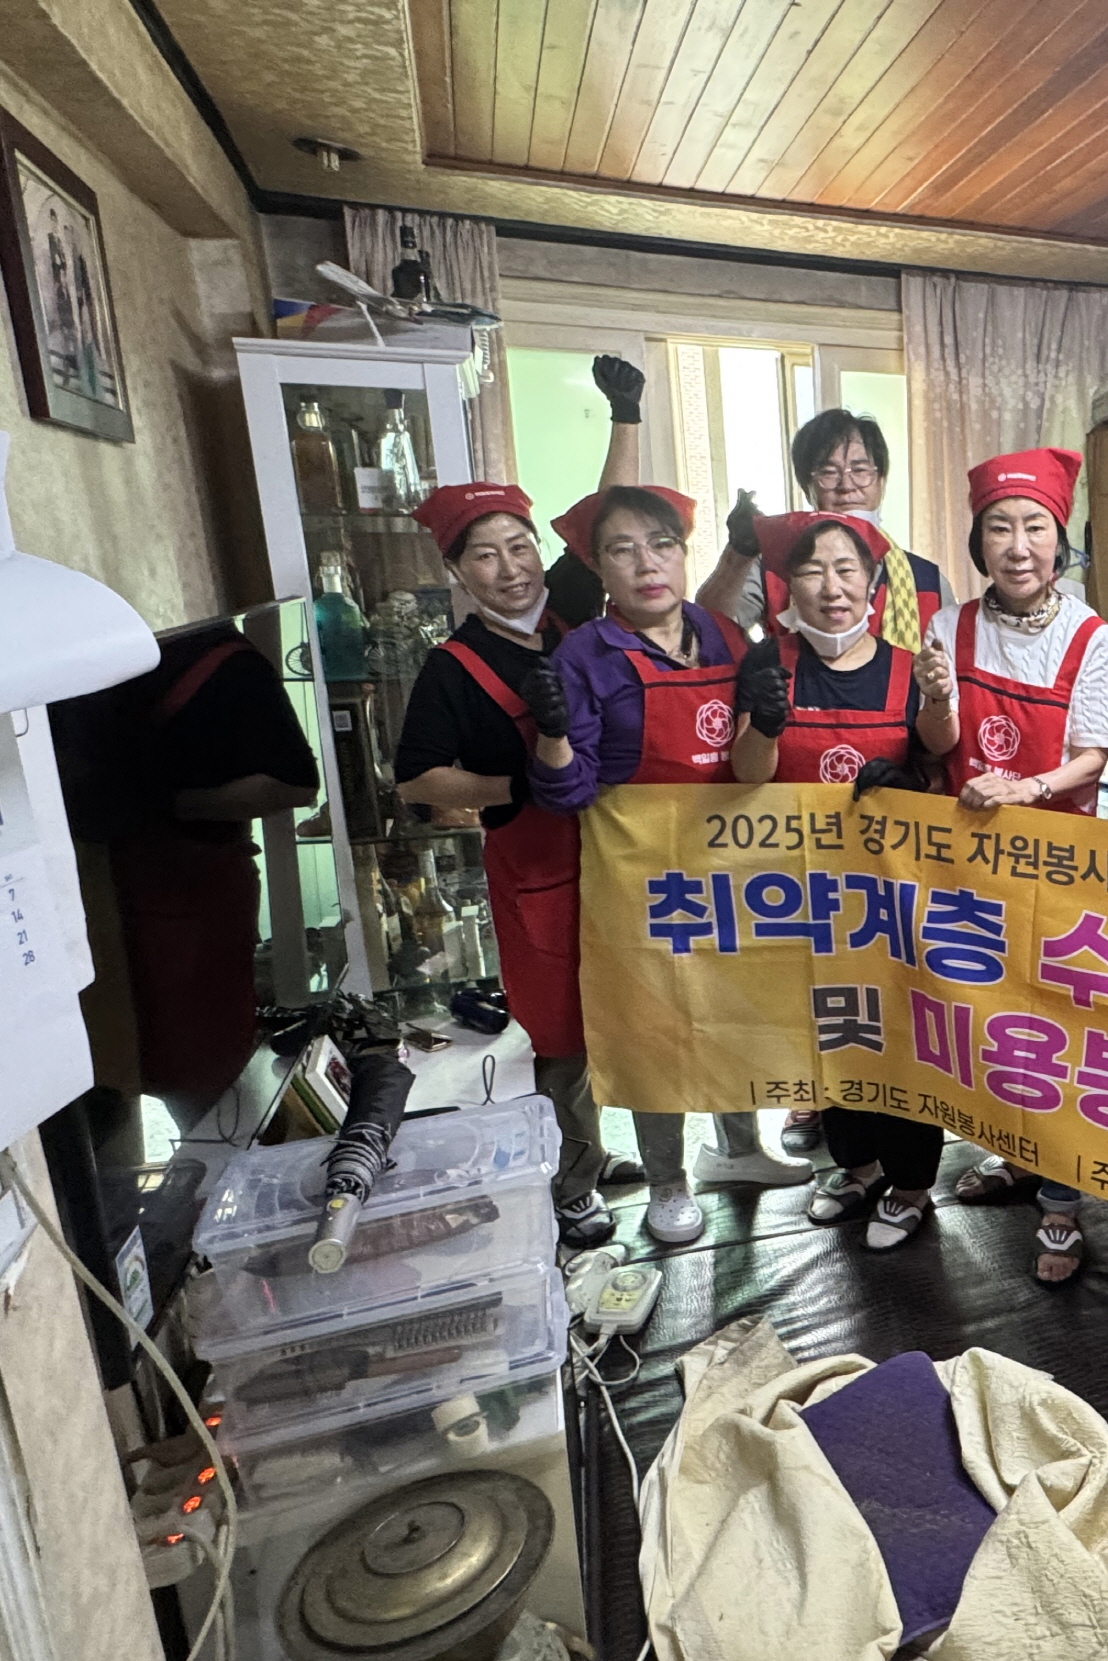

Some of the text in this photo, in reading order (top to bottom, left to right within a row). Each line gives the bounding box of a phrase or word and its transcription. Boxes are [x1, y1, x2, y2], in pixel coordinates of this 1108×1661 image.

[706, 812, 845, 850] 2025년
[858, 814, 955, 865] 경기도
[8, 888, 15, 901] 7
[11, 908, 24, 923] 14
[645, 869, 1007, 986] 취약계층
[17, 929, 28, 945] 21
[22, 950, 36, 967] 28
[811, 984, 886, 1055] 및
[839, 1080, 911, 1112] 경기도
[918, 1092, 1040, 1167] 자원봉사센터
